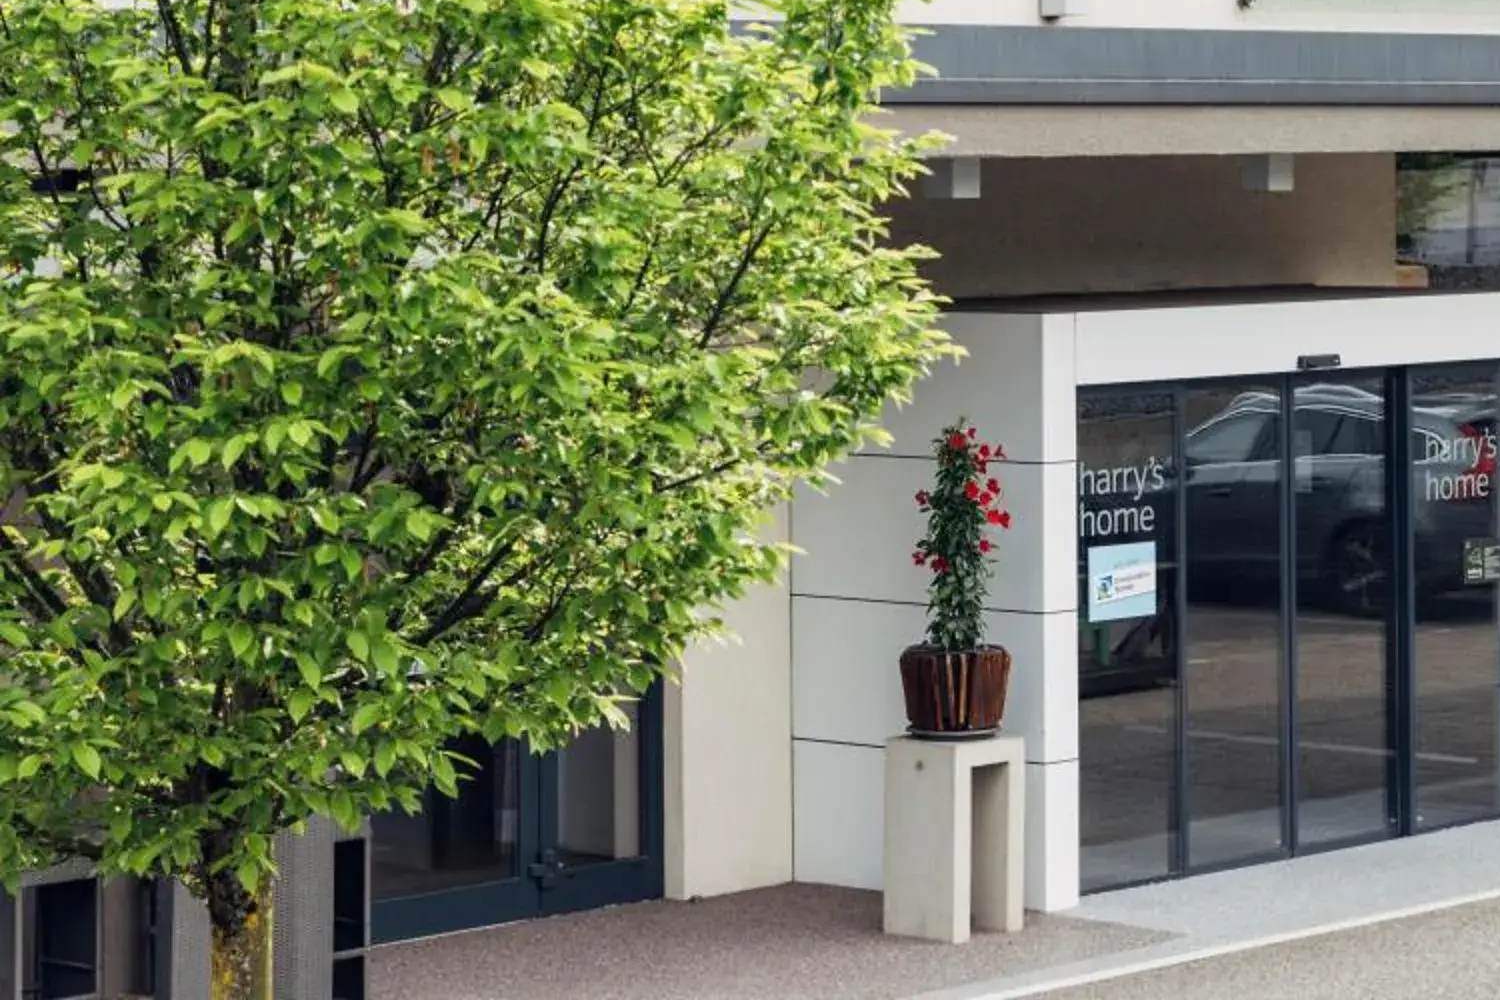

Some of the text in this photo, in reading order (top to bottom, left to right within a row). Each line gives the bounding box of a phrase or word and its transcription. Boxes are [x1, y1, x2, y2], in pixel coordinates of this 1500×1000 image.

[1425, 427, 1498, 468] harry's
[1079, 456, 1165, 501] harry's
[1425, 469, 1489, 501] home
[1079, 501, 1155, 537] home
